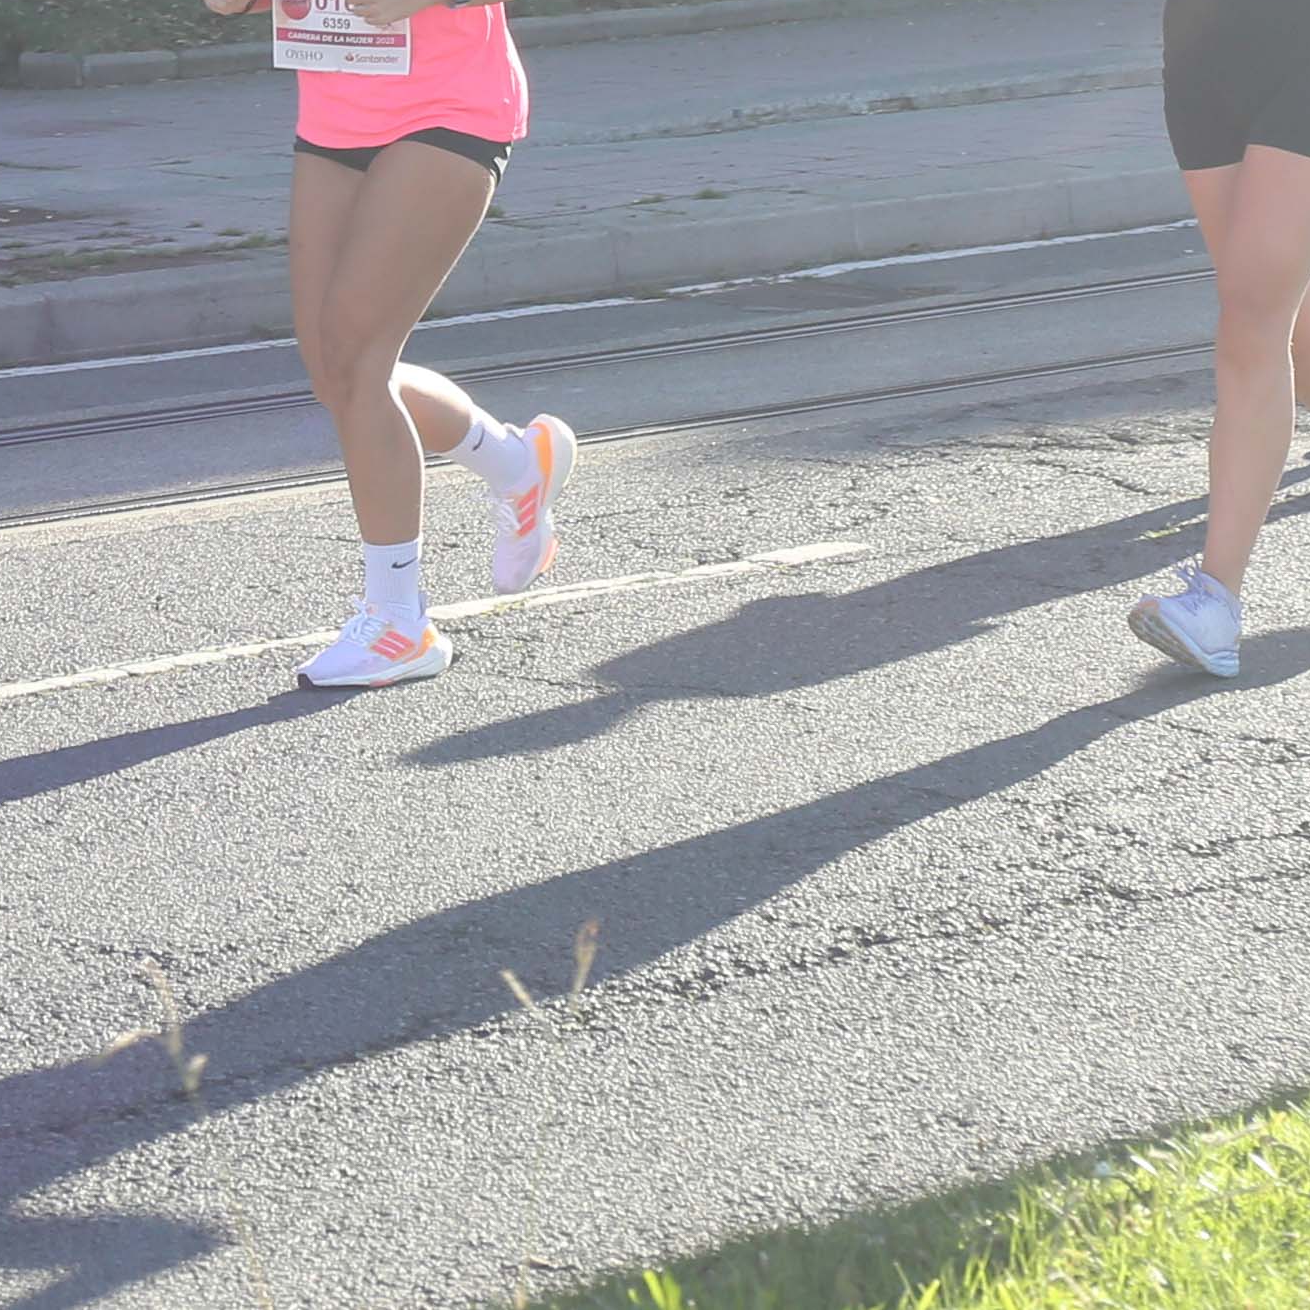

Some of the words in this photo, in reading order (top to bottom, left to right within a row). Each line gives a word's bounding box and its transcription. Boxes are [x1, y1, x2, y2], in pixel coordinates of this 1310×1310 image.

[322, 17, 351, 29] 6359
[334, 35, 345, 43] LA
[354, 52, 400, 64] Santander
